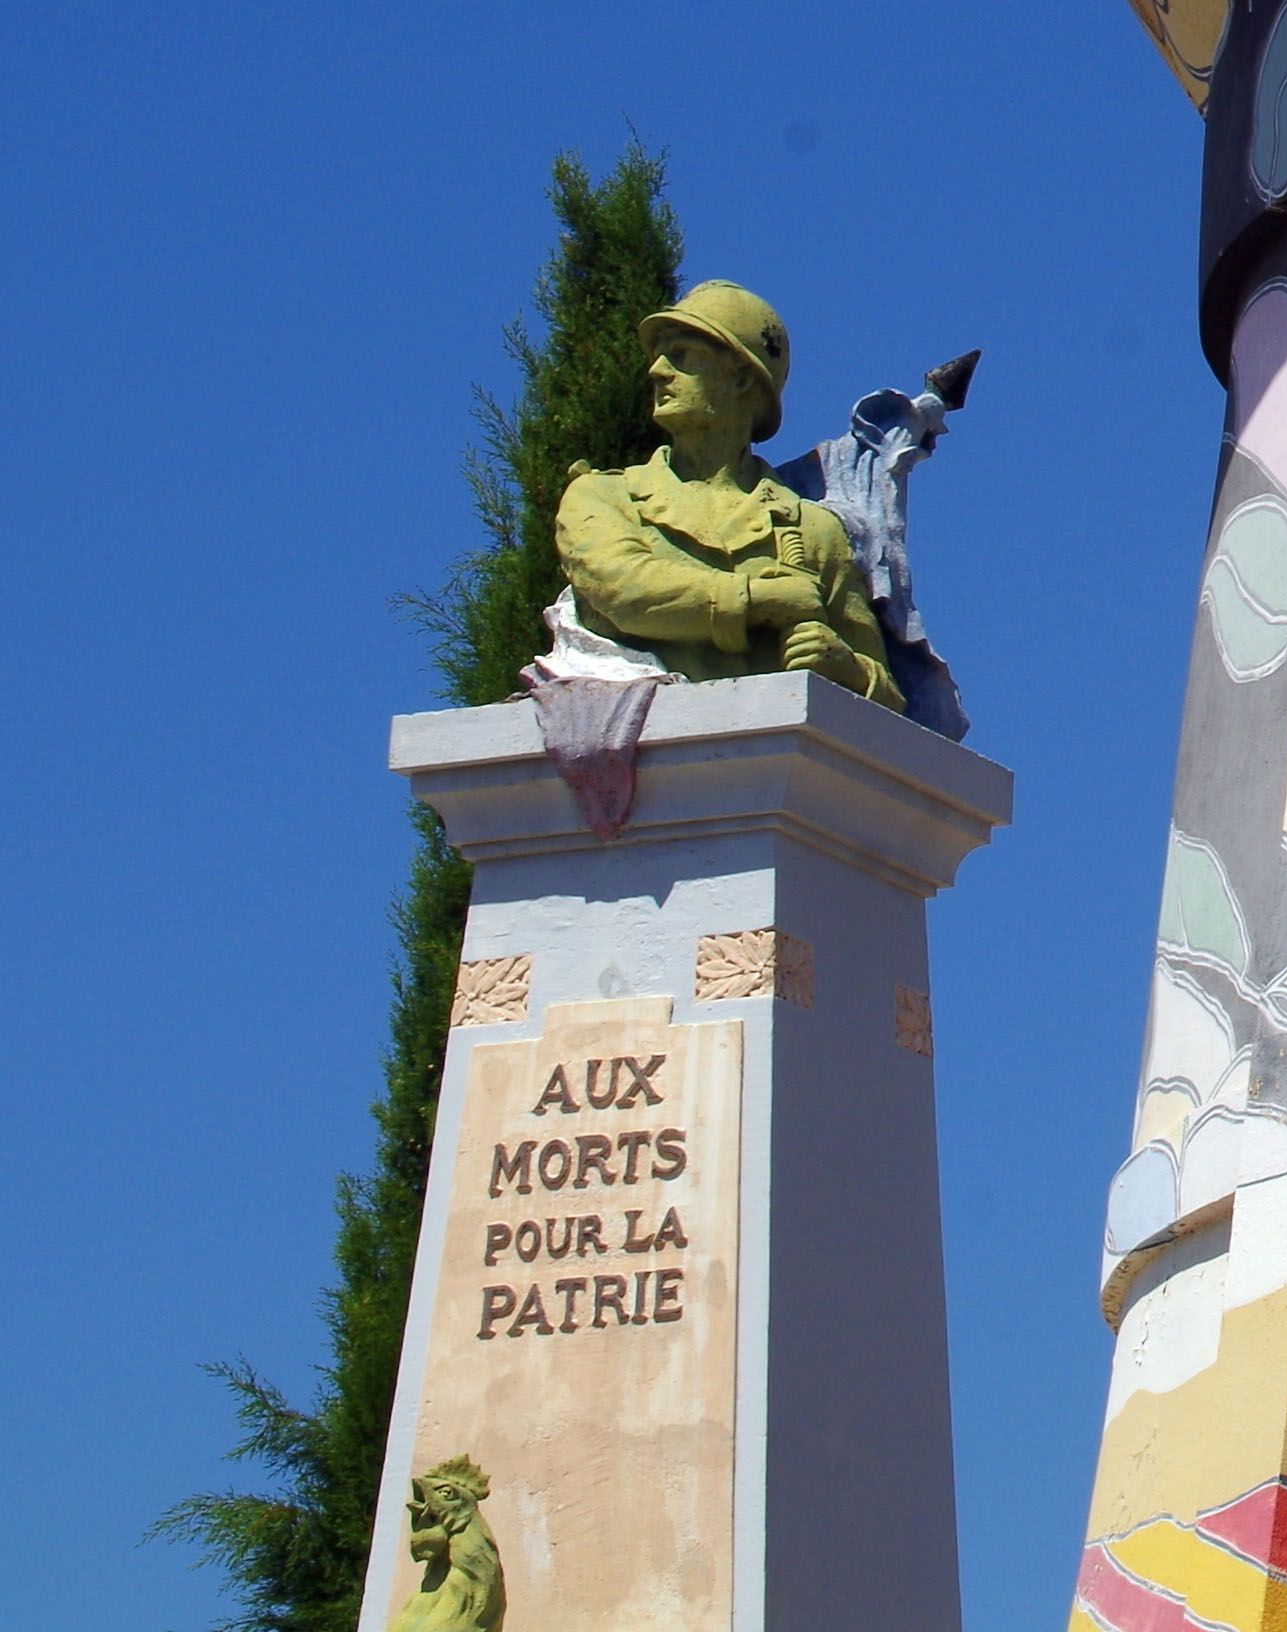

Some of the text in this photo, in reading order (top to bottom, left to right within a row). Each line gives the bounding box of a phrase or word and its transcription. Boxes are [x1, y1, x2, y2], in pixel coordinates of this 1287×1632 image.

[532, 1054, 667, 1116] AUX
[488, 1128, 688, 1198] MORTS
[484, 1206, 688, 1267] POUR LA
[476, 1268, 686, 1340] PATRIE
